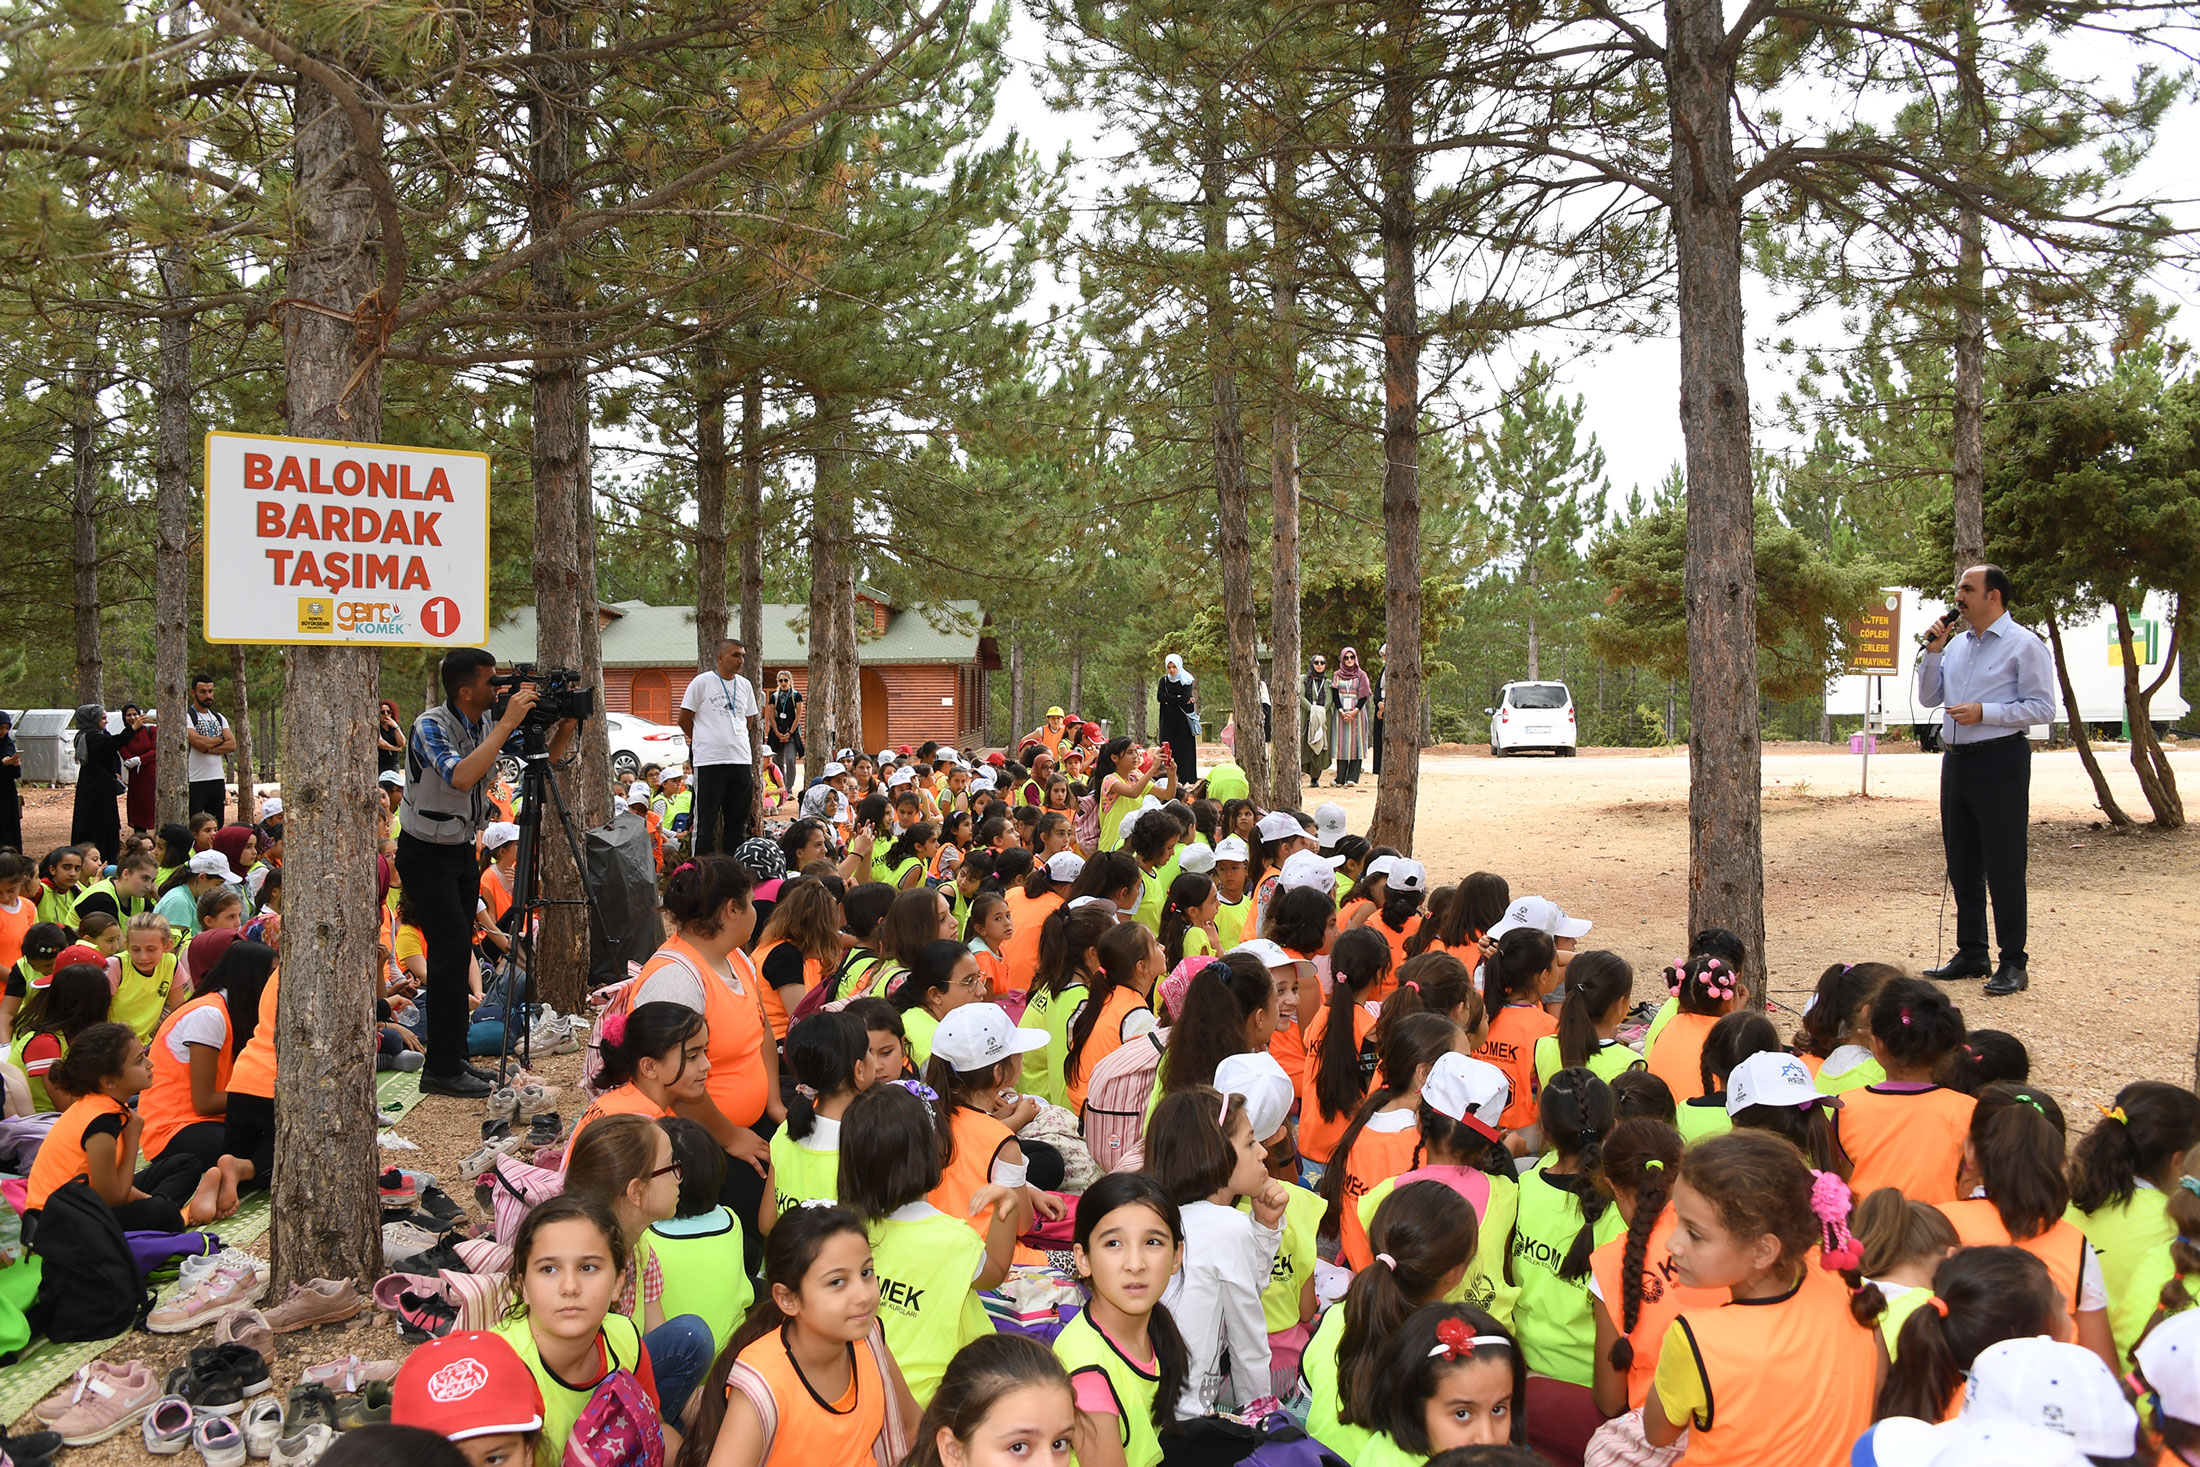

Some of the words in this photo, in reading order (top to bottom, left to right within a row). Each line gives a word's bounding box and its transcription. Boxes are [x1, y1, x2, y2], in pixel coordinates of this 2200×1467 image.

[243, 452, 455, 503] BALONLA
[256, 501, 443, 546] BARDAK
[265, 548, 432, 595] TAŞIMA
[336, 601, 391, 631] genç
[355, 622, 404, 635] KOMEK
[430, 600, 446, 634] 1
[889, 1303, 918, 1319] KURSLARI
